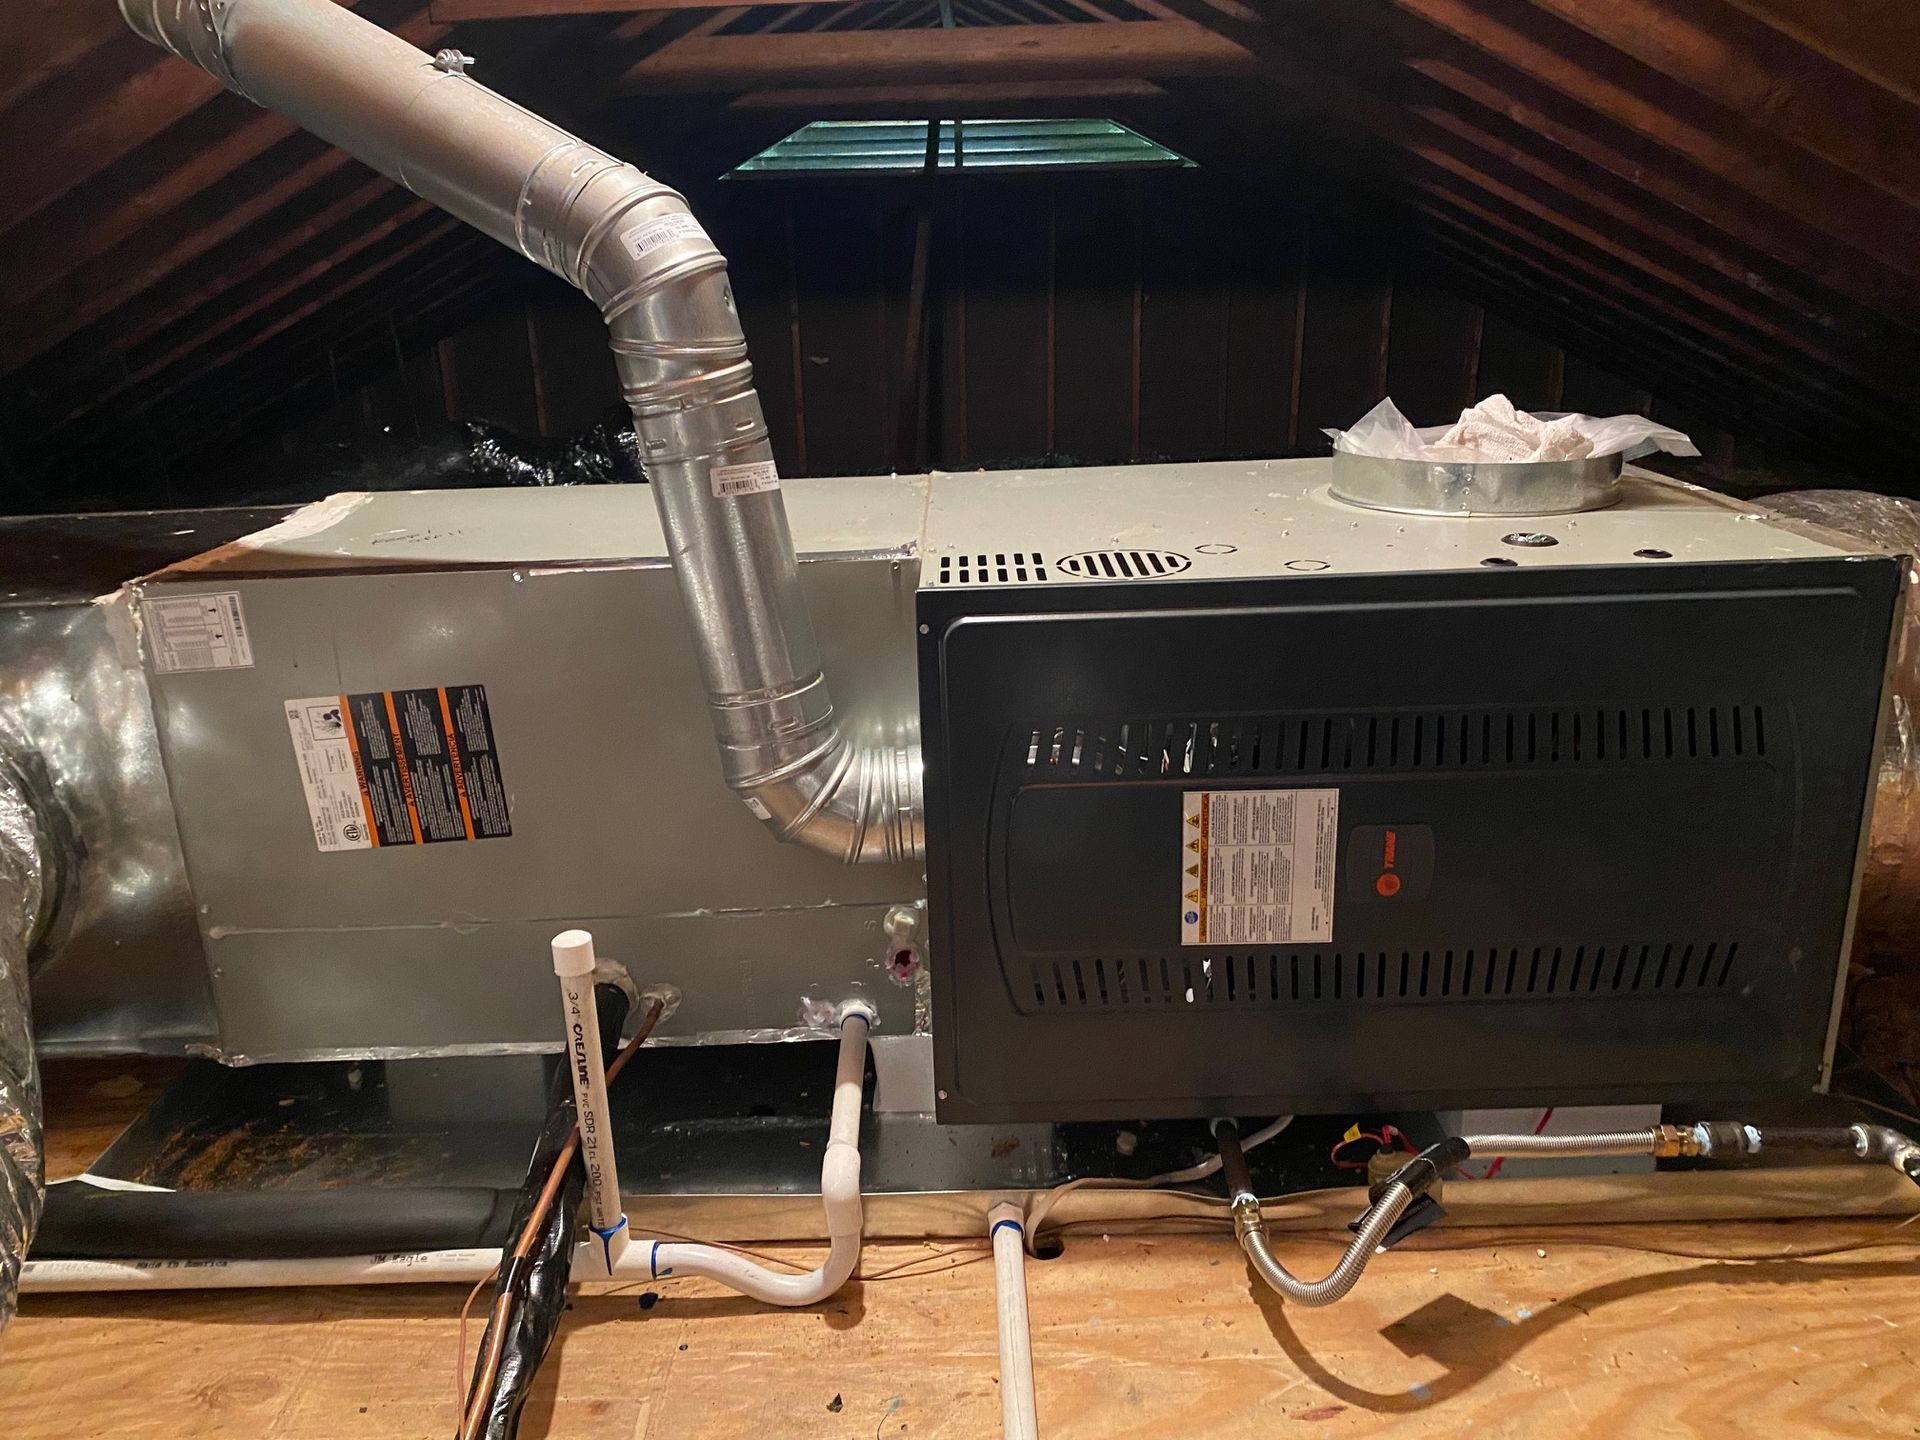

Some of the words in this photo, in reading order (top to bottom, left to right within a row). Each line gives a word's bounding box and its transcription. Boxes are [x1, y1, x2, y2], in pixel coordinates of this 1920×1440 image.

[352, 751, 368, 792] WARNING
[581, 1093, 590, 1109] PVC
[584, 1111, 596, 1134] SDR
[586, 1136, 598, 1150] 21
[590, 1163, 603, 1188] 200
[185, 1260, 228, 1268] America
[392, 1253, 428, 1266] Eagle
